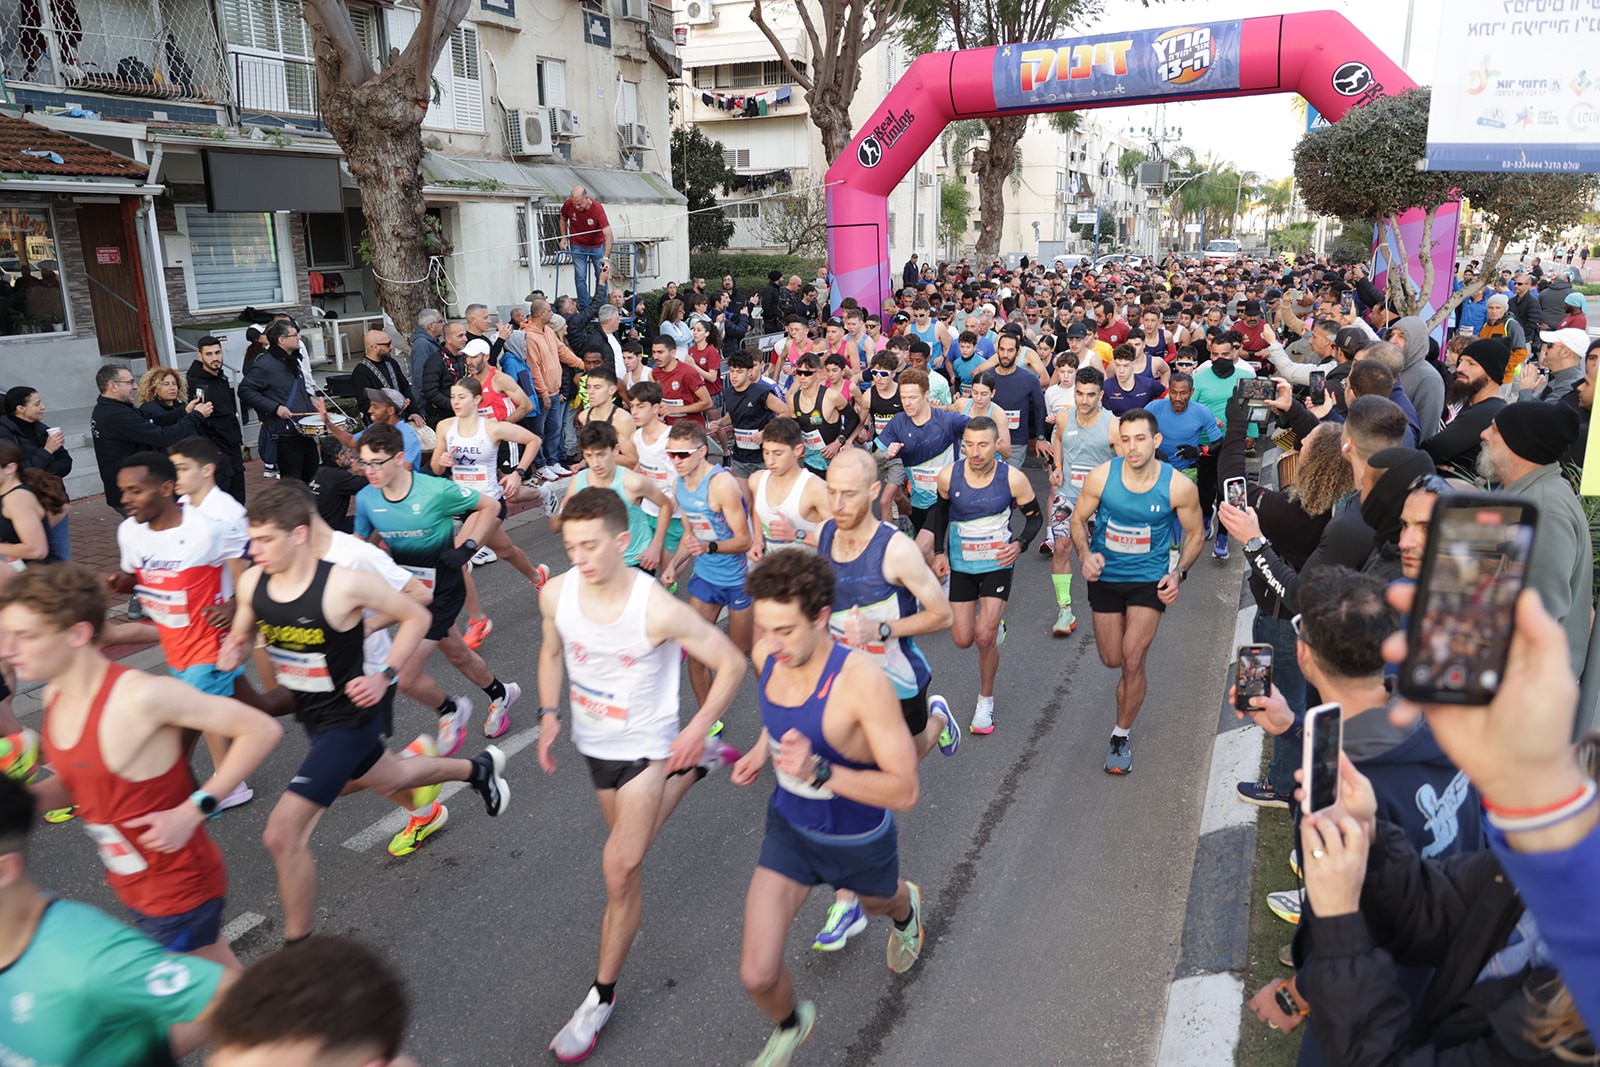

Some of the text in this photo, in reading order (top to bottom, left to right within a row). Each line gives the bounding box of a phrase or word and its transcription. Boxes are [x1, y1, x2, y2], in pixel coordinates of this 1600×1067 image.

[1151, 28, 1211, 63] מרוץ
[1168, 41, 1210, 61] אור יהודה
[1021, 39, 1133, 92] זינוק
[1157, 48, 1210, 82] ה-13
[874, 109, 895, 138] Real
[880, 108, 915, 147] Timing
